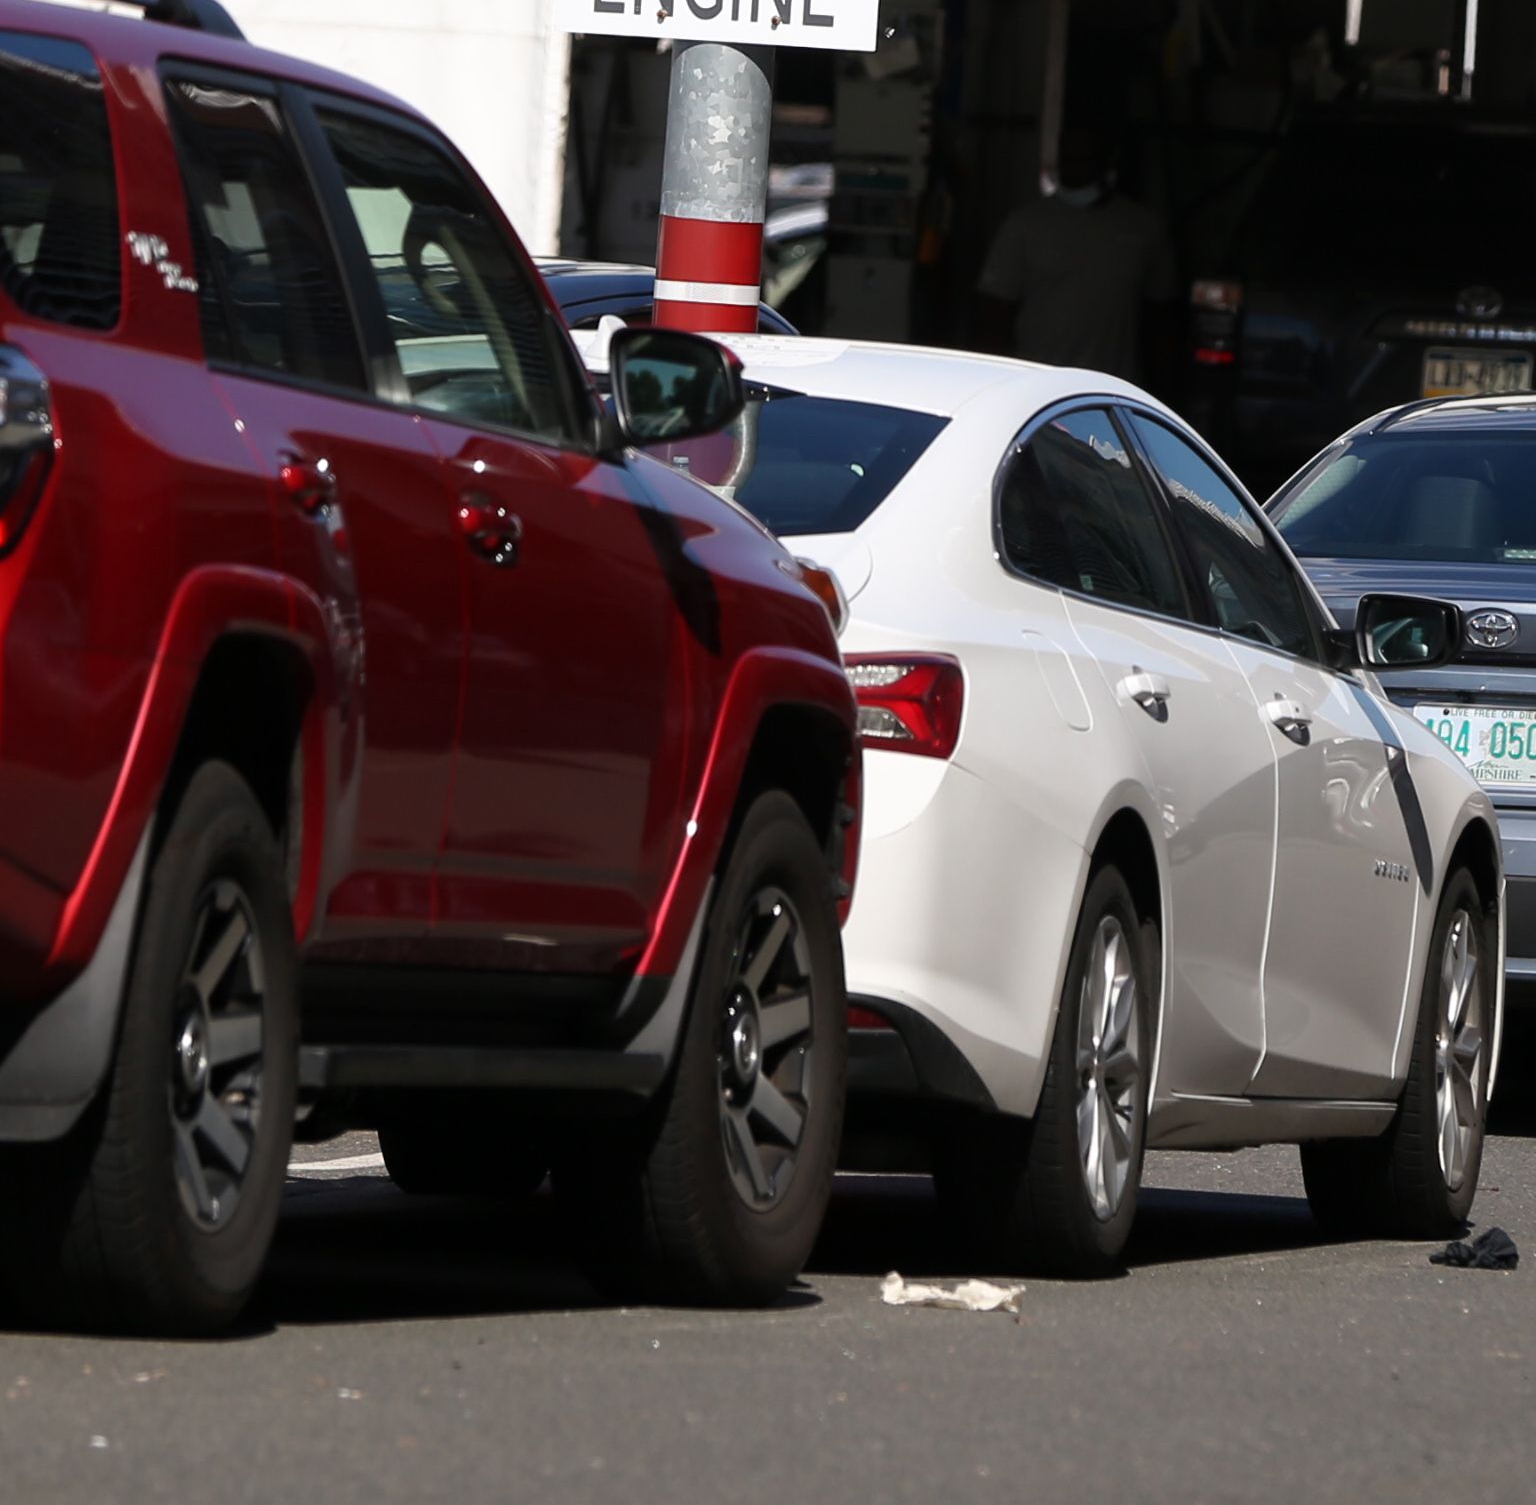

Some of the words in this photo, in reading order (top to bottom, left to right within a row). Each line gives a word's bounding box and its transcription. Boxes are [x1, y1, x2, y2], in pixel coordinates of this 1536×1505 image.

[1450, 707, 1468, 717] LIVE
[1474, 709, 1496, 718] FREE
[1501, 710, 1514, 719] OR
[1519, 711, 1534, 720] DIE
[1426, 718, 1470, 757] 94
